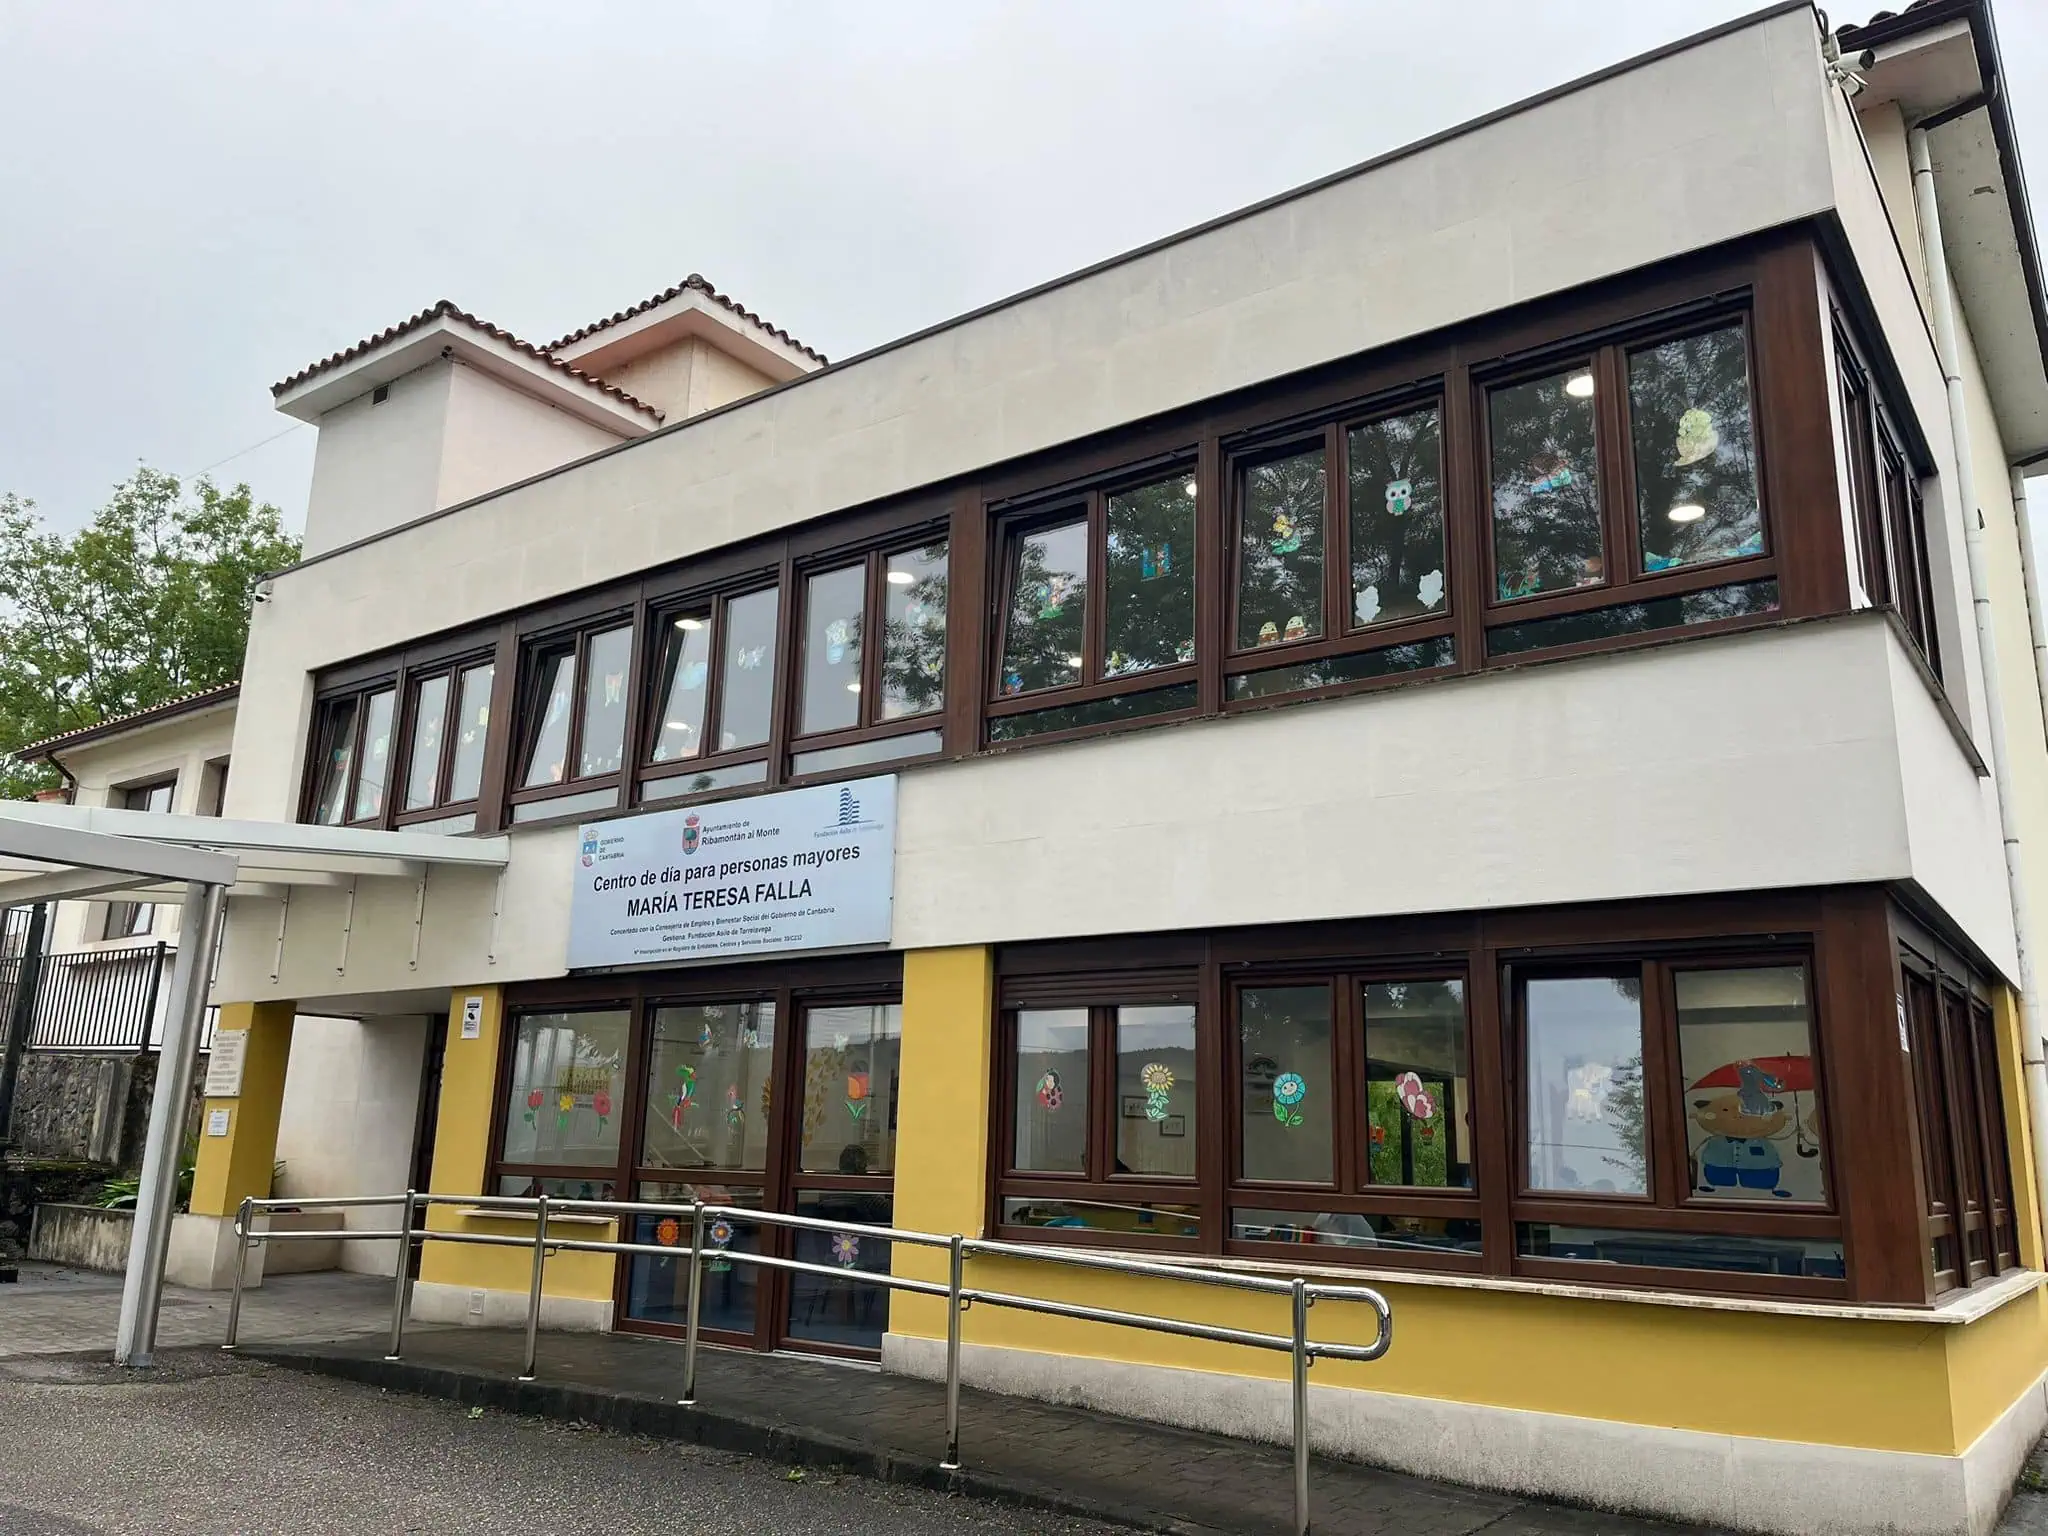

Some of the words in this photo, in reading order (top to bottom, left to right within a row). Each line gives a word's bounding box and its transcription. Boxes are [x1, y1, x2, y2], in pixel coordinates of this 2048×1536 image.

[702, 832, 746, 845] Ribamontán
[748, 830, 754, 839] al
[756, 828, 780, 838] Monte
[703, 822, 742, 834] Ayuntamiento
[594, 874, 636, 892] Centro
[640, 870, 656, 886] de
[660, 866, 680, 883] día
[685, 865, 716, 884] para
[720, 856, 788, 880] personas
[793, 846, 860, 868] mayores
[627, 891, 678, 916] MARÍA
[684, 886, 750, 910] TERESA
[755, 878, 812, 902] FALLA
[742, 914, 760, 922] Social
[770, 910, 797, 920] Gobierno
[806, 906, 835, 916] Cantabria
